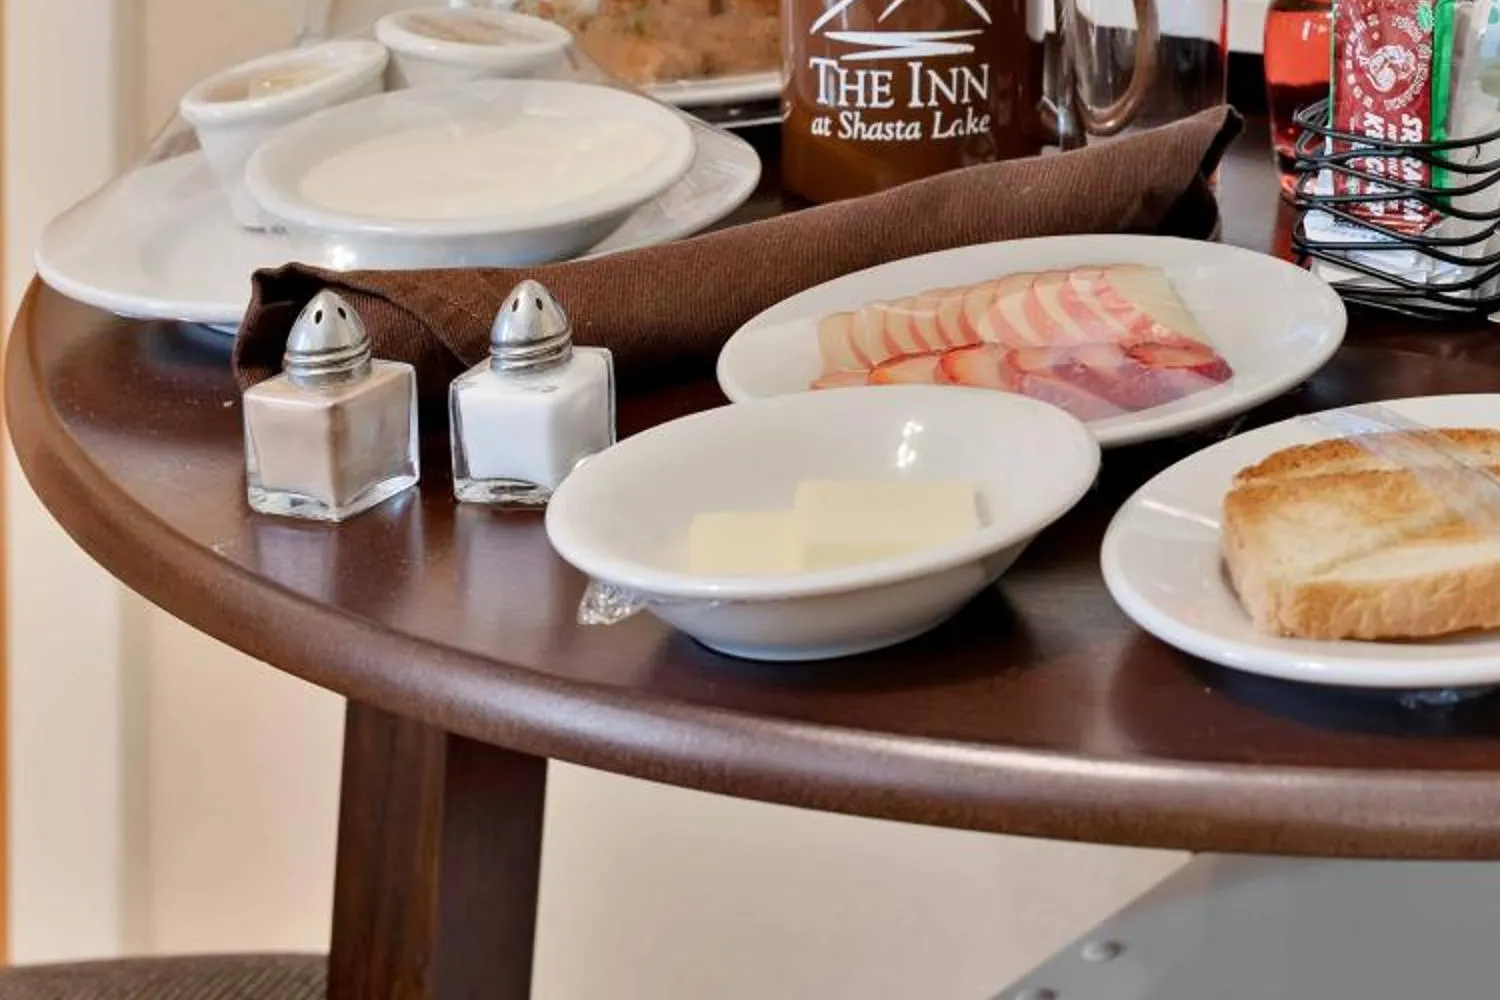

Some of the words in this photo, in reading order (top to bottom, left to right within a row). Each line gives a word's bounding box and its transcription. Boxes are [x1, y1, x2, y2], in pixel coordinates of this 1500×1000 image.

[809, 57, 895, 108] THE
[908, 61, 989, 108] INN
[811, 116, 832, 136] at
[838, 111, 922, 141] Shasta
[930, 107, 991, 139] Lake
